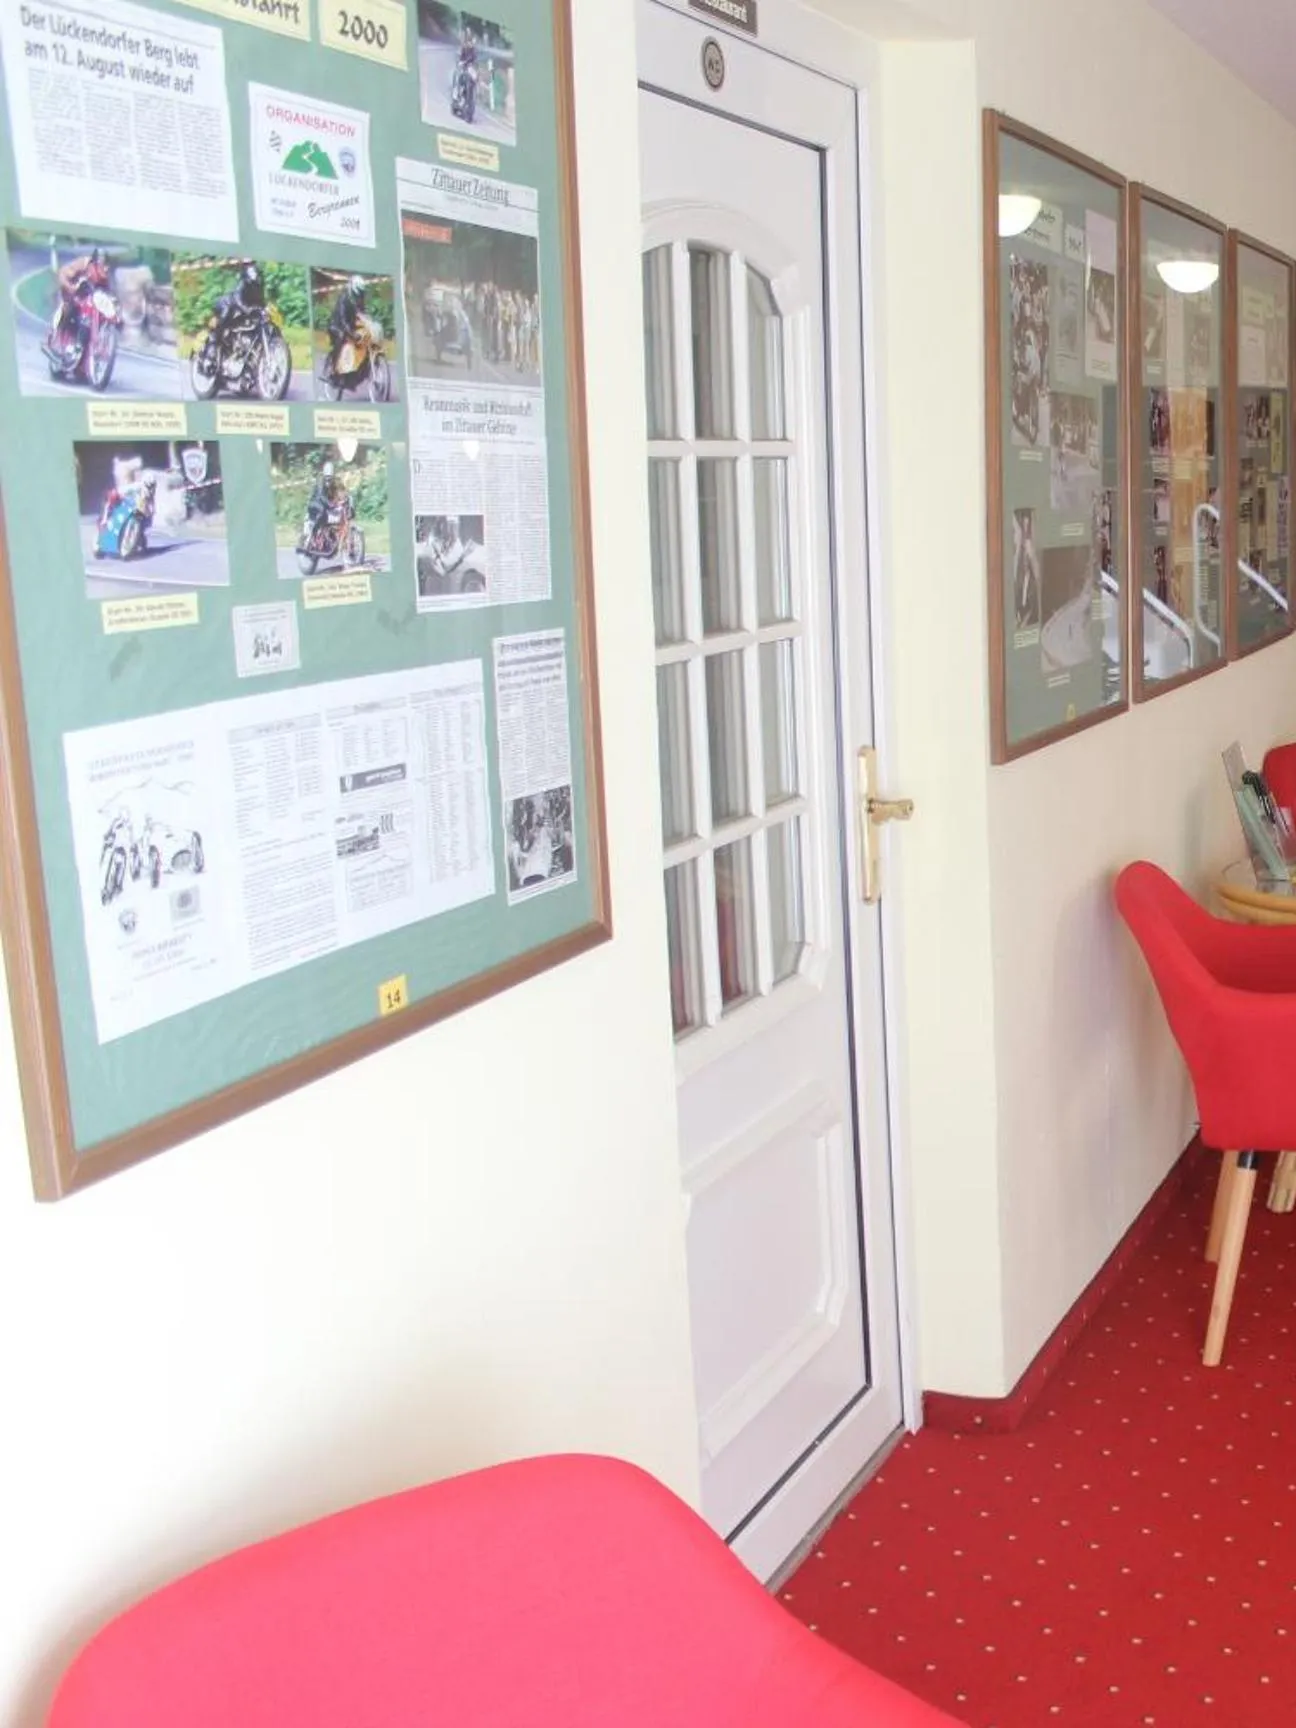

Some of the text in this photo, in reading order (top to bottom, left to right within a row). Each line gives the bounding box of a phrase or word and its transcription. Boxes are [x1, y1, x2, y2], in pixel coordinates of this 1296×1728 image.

[20, 5, 200, 70] Der Lückendorfer Berg lebt
[338, 10, 389, 49] 2000
[24, 40, 195, 95] am 12. August wieder auf
[265, 104, 356, 138] ORGANISATION
[387, 988, 401, 1009] 14
